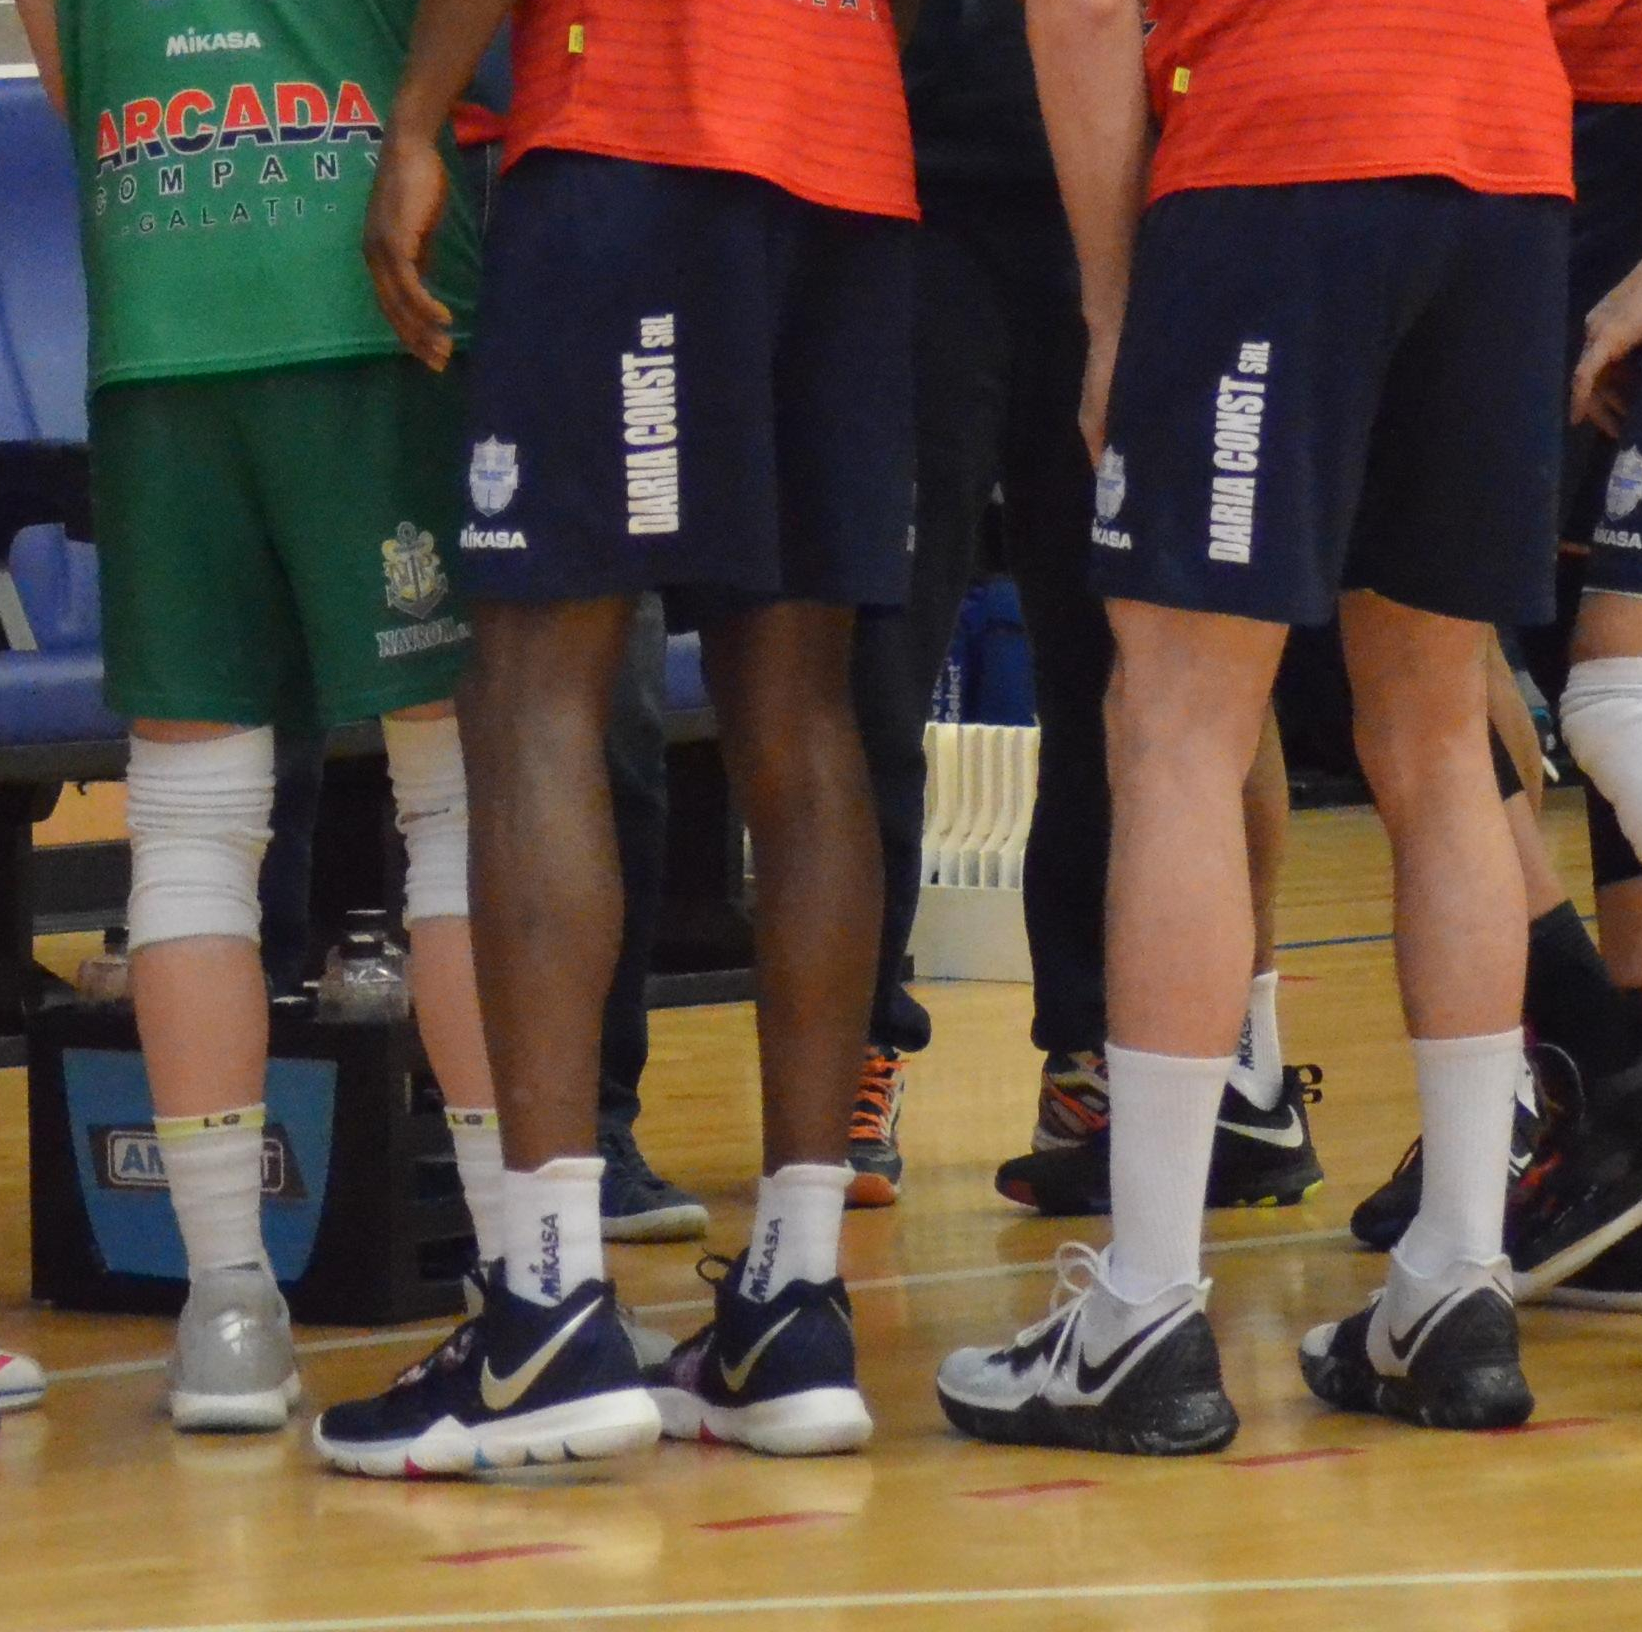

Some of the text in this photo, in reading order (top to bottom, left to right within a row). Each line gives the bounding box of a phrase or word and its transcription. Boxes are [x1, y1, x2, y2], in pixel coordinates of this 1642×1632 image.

[95, 79, 385, 179] ARCADA
[621, 313, 680, 536] DARIA CONST SRL
[1208, 340, 1271, 565] DARIA CONST SRL
